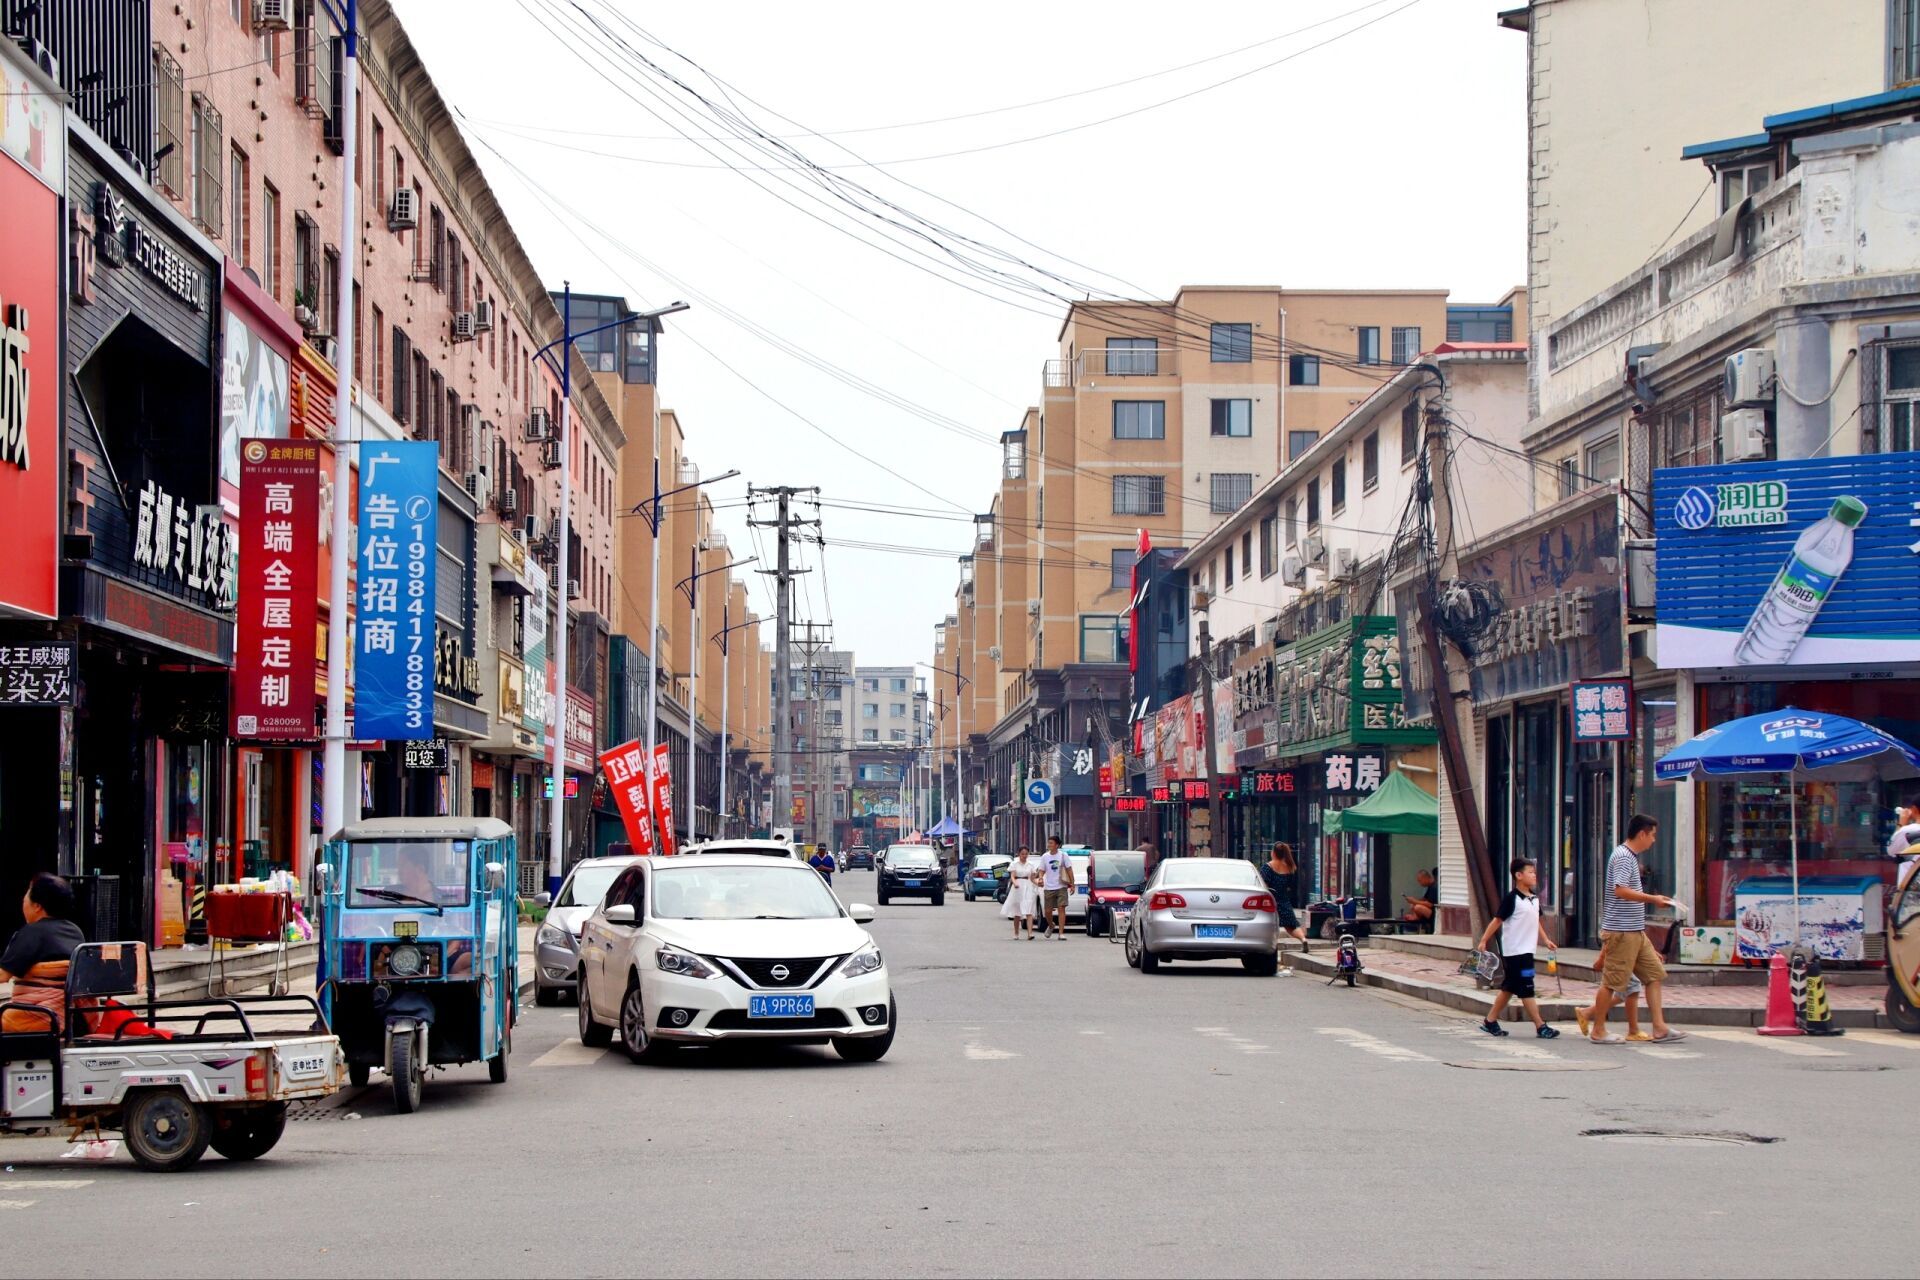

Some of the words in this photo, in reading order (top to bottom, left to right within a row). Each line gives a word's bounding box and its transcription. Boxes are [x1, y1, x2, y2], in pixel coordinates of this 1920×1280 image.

[270, 447, 316, 461] 金牌厨柜
[1719, 482, 1784, 511] 润田
[362, 452, 401, 655] 广告位招商
[261, 482, 294, 707] 高端全屋定制
[1787, 582, 1815, 603] 润田
[405, 524, 426, 729] 19984178833
[0, 669, 70, 702] 染欢
[1576, 685, 1627, 711] 新锐
[263, 717, 301, 726] 6280099
[1577, 711, 1629, 737] 造型
[1256, 772, 1294, 792] 旅馆
[1325, 754, 1382, 791] 药房
[771, 997, 812, 1014] 9PR66
